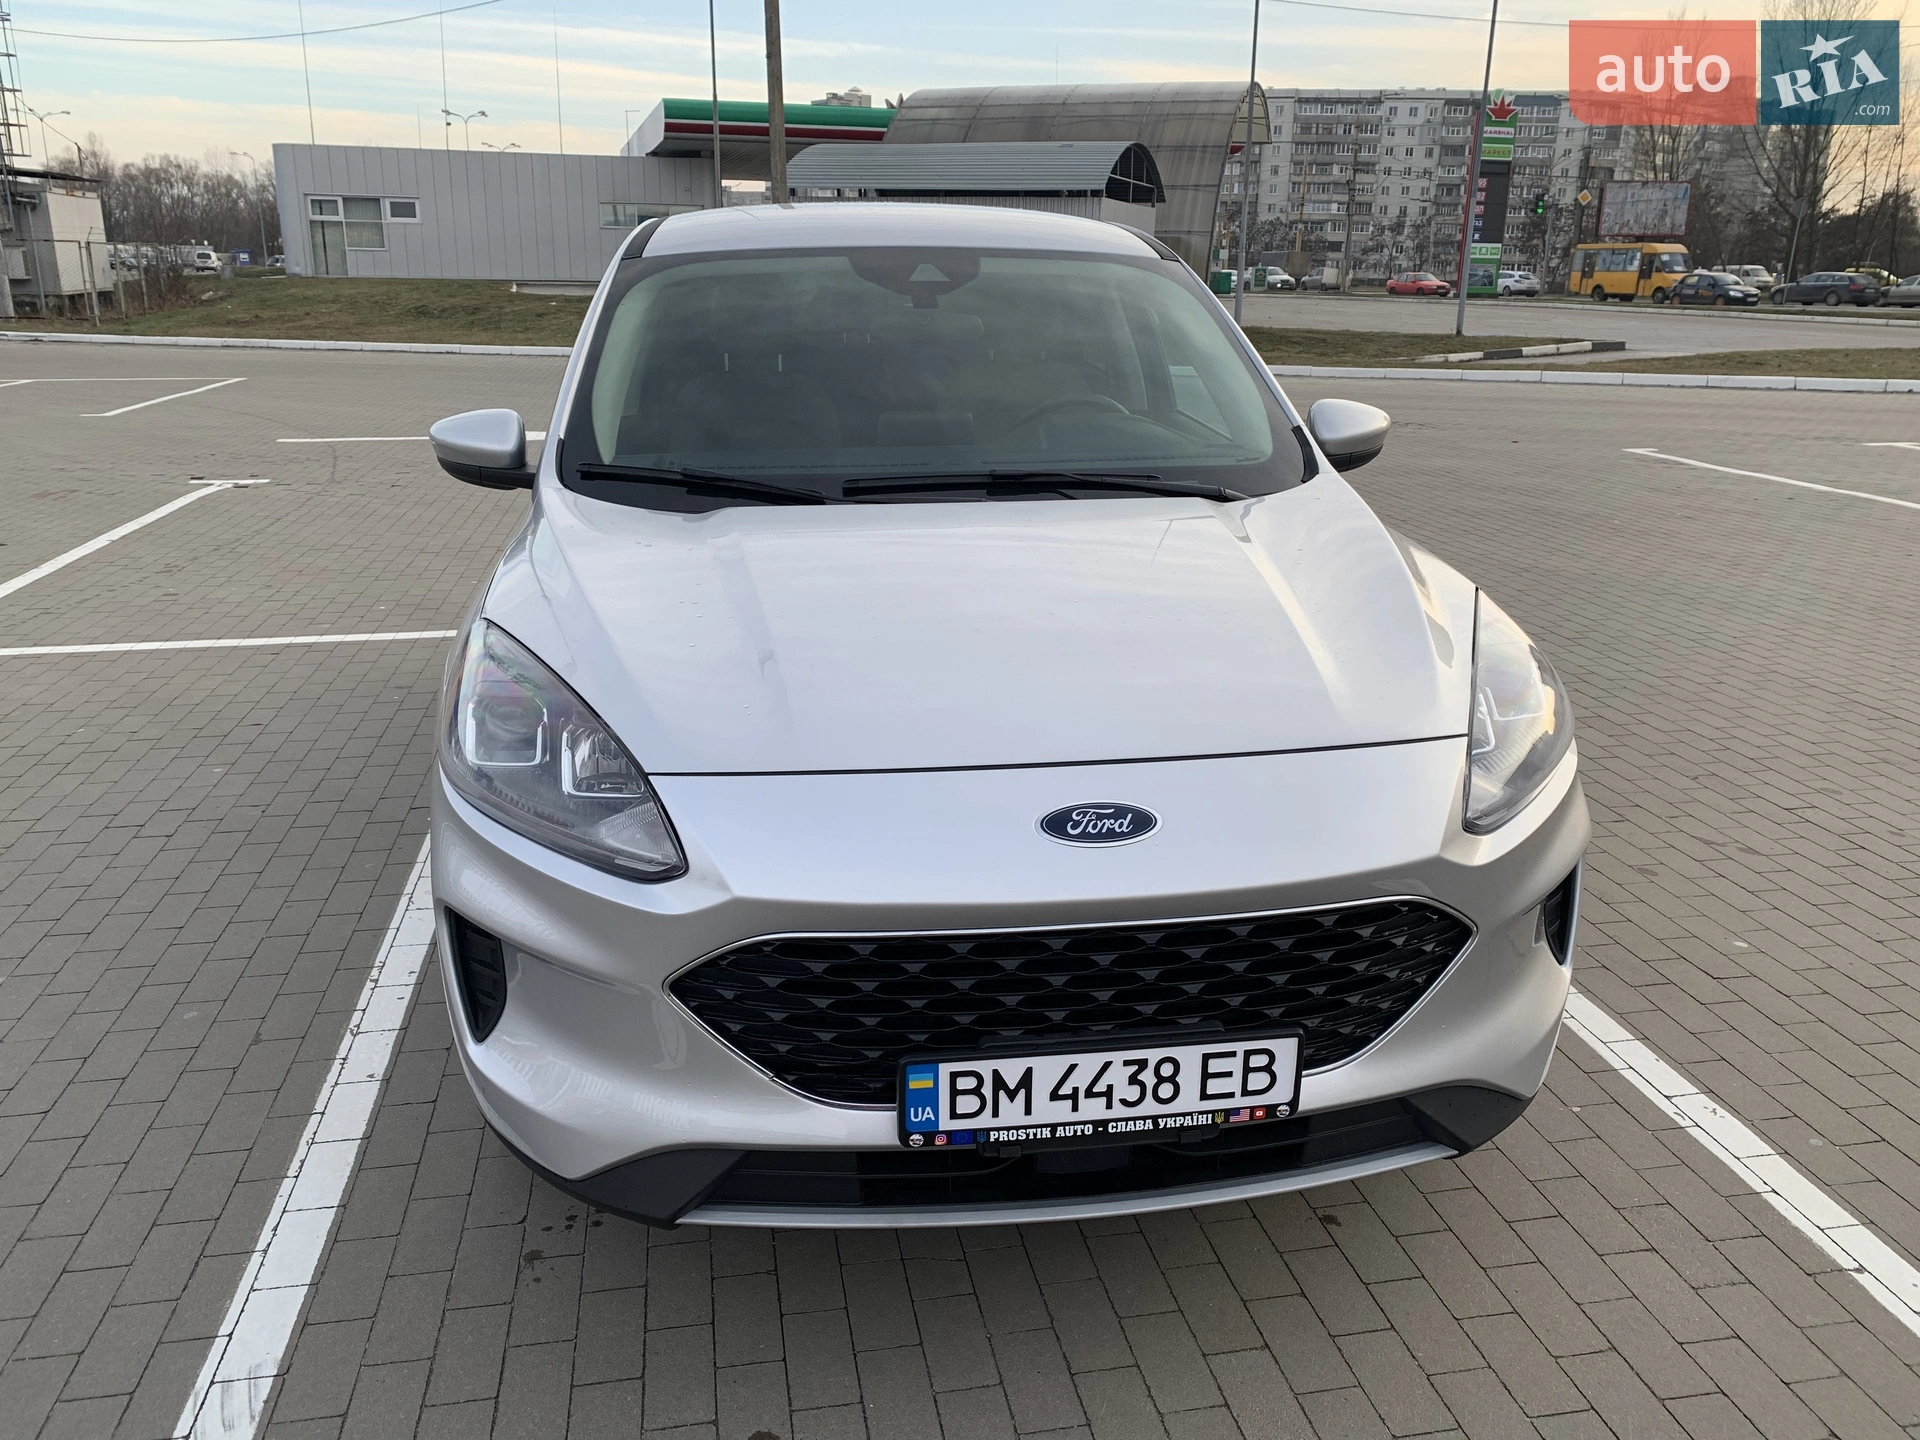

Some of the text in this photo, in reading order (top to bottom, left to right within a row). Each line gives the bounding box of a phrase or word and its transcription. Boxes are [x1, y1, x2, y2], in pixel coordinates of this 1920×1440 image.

[1066, 808, 1133, 835] Ford
[949, 1048, 1277, 1120] BM 4438 EB
[910, 1106, 936, 1122] UA
[989, 1127, 1052, 1142] PROSTIK
[1055, 1124, 1093, 1138] AUTO
[1107, 1119, 1154, 1133] СЛАВА
[1157, 1113, 1213, 1129] УКРАЇНІ
